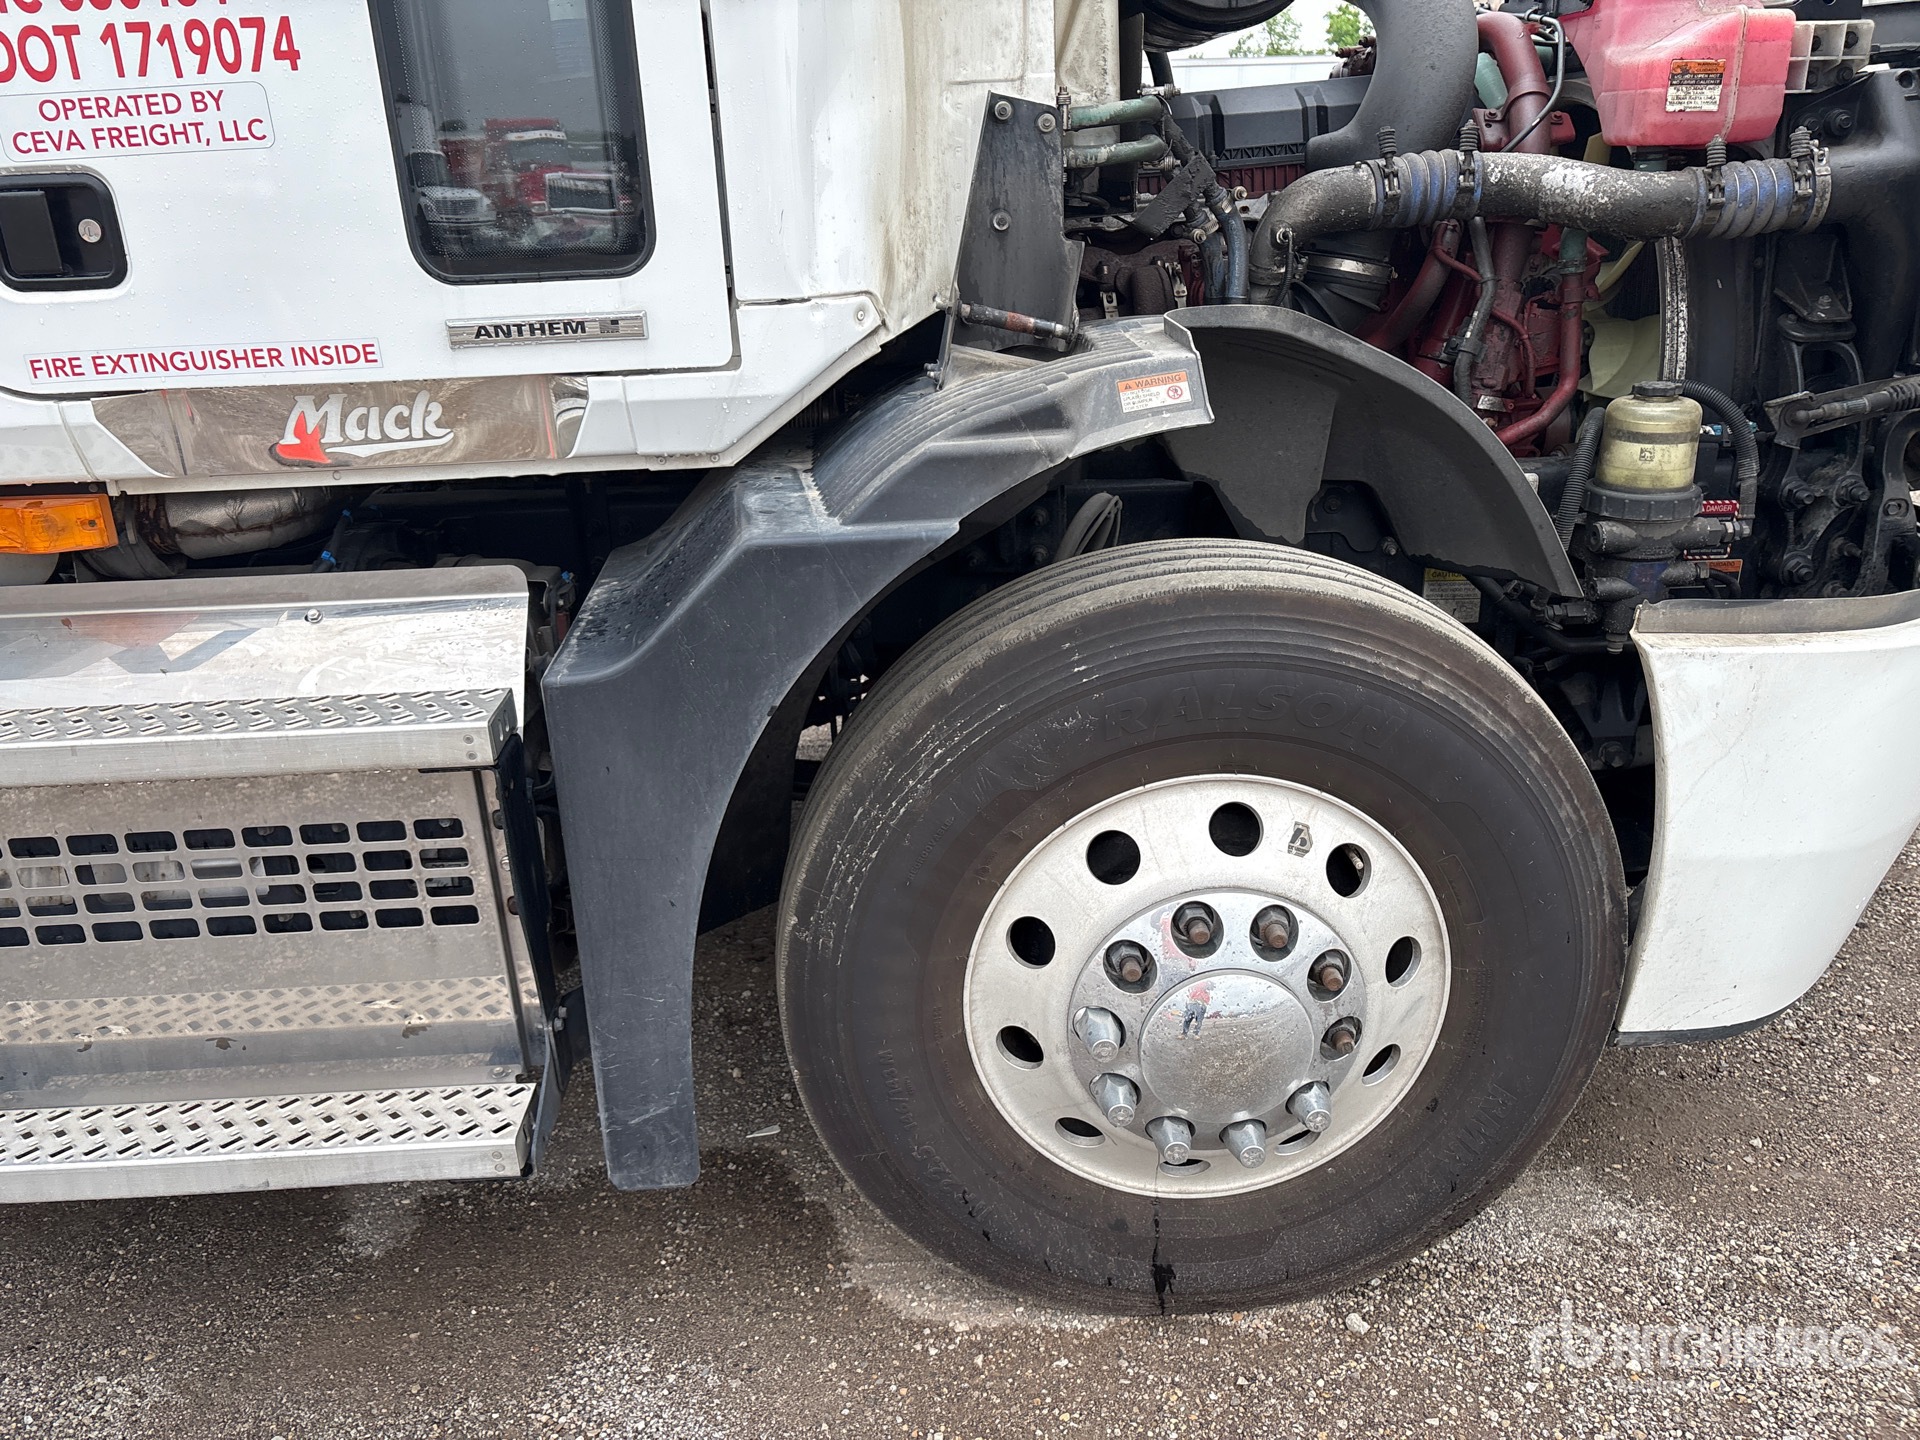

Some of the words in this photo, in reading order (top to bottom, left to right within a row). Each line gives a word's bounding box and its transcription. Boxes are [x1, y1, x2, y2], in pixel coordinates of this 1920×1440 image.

[100, 16, 300, 78] 1719074
[38, 93, 182, 122] OPERATED
[191, 90, 224, 112] BY
[12, 129, 86, 154] CEVA
[92, 121, 211, 149] FREIGHT,
[219, 118, 268, 142] LLC
[474, 321, 586, 340] ANTHEM
[29, 355, 83, 380] FIRE
[91, 346, 284, 376] EXTINGUISHER
[291, 342, 379, 368] INSIDE
[1134, 374, 1182, 388] WARNING
[281, 392, 453, 447] Mack
[1099, 682, 1405, 752] RALSON
